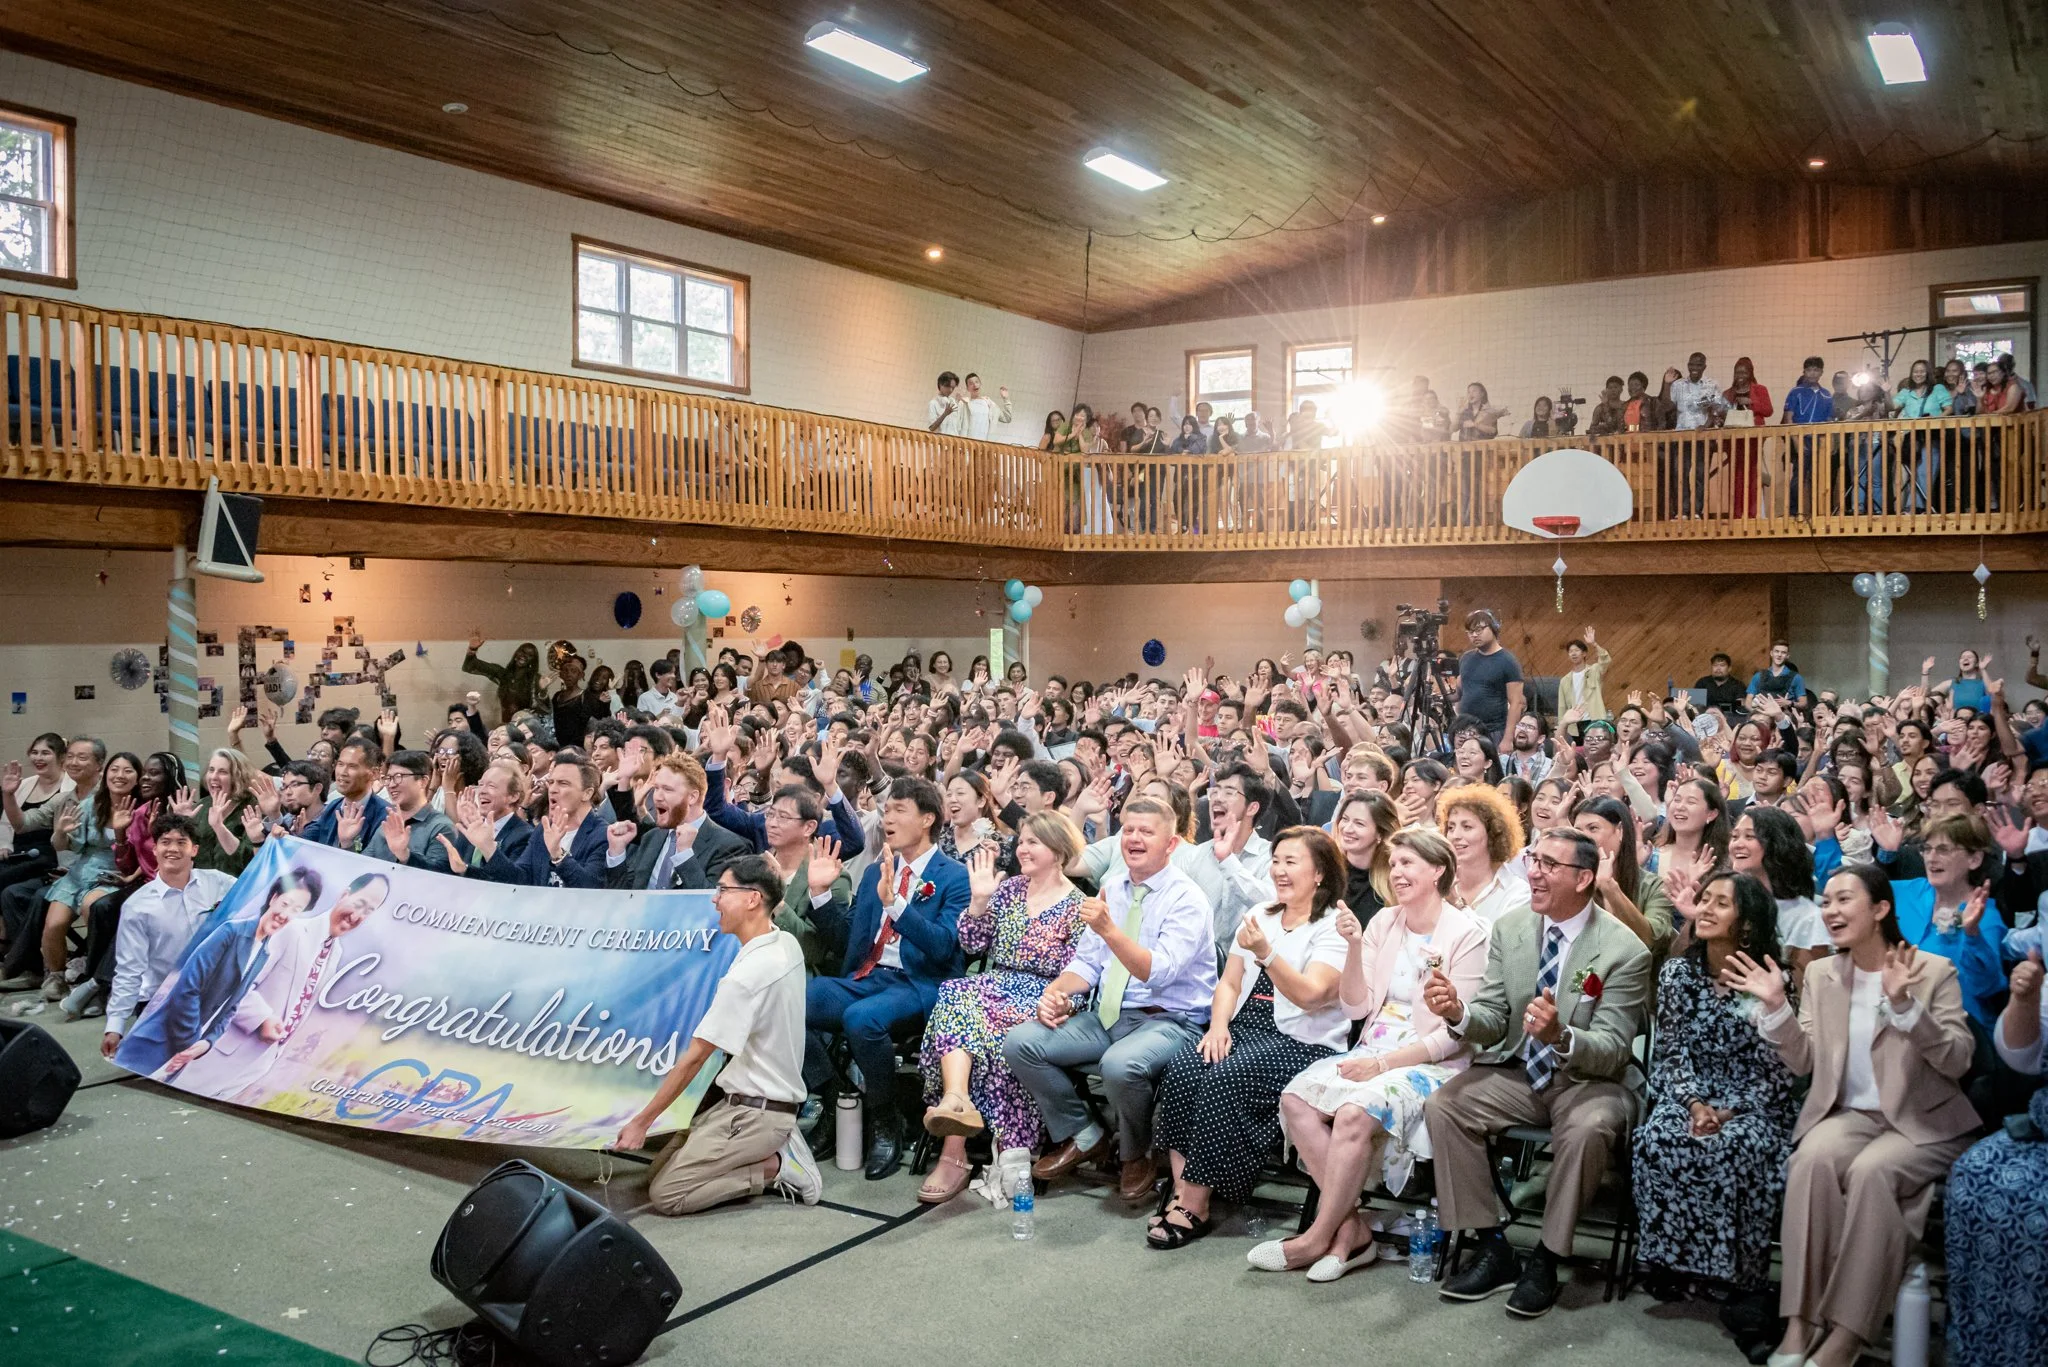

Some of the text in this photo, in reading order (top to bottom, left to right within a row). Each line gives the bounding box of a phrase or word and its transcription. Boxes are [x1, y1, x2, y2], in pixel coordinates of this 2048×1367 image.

[392, 901, 718, 952] COMMENCEMENT CEREMONY
[318, 952, 680, 1076] Congratulations
[310, 1078, 557, 1134] Generation Peace Academy
[335, 1058, 514, 1136] GPA
